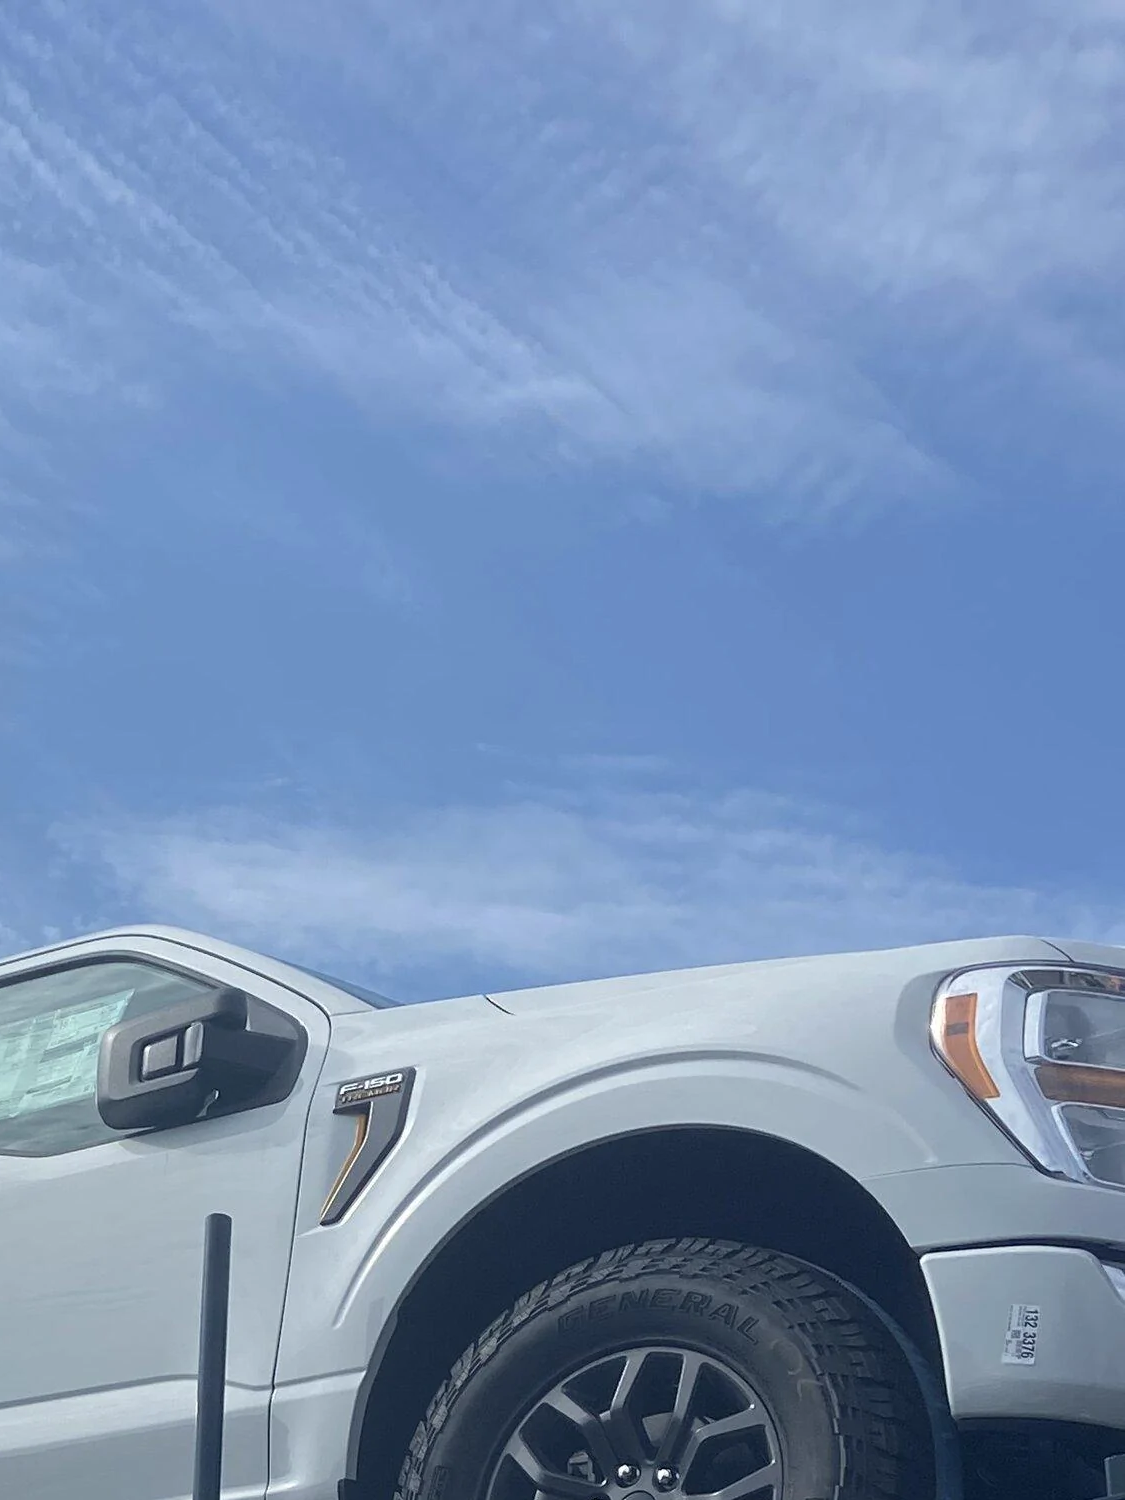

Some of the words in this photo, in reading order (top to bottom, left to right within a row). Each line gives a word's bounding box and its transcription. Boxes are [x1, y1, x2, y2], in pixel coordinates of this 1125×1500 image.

[339, 1073, 403, 1095] F-150
[557, 1288, 760, 1345] GENERAL
[1024, 1309, 1038, 1329] 132
[1021, 1332, 1036, 1359] 3376
